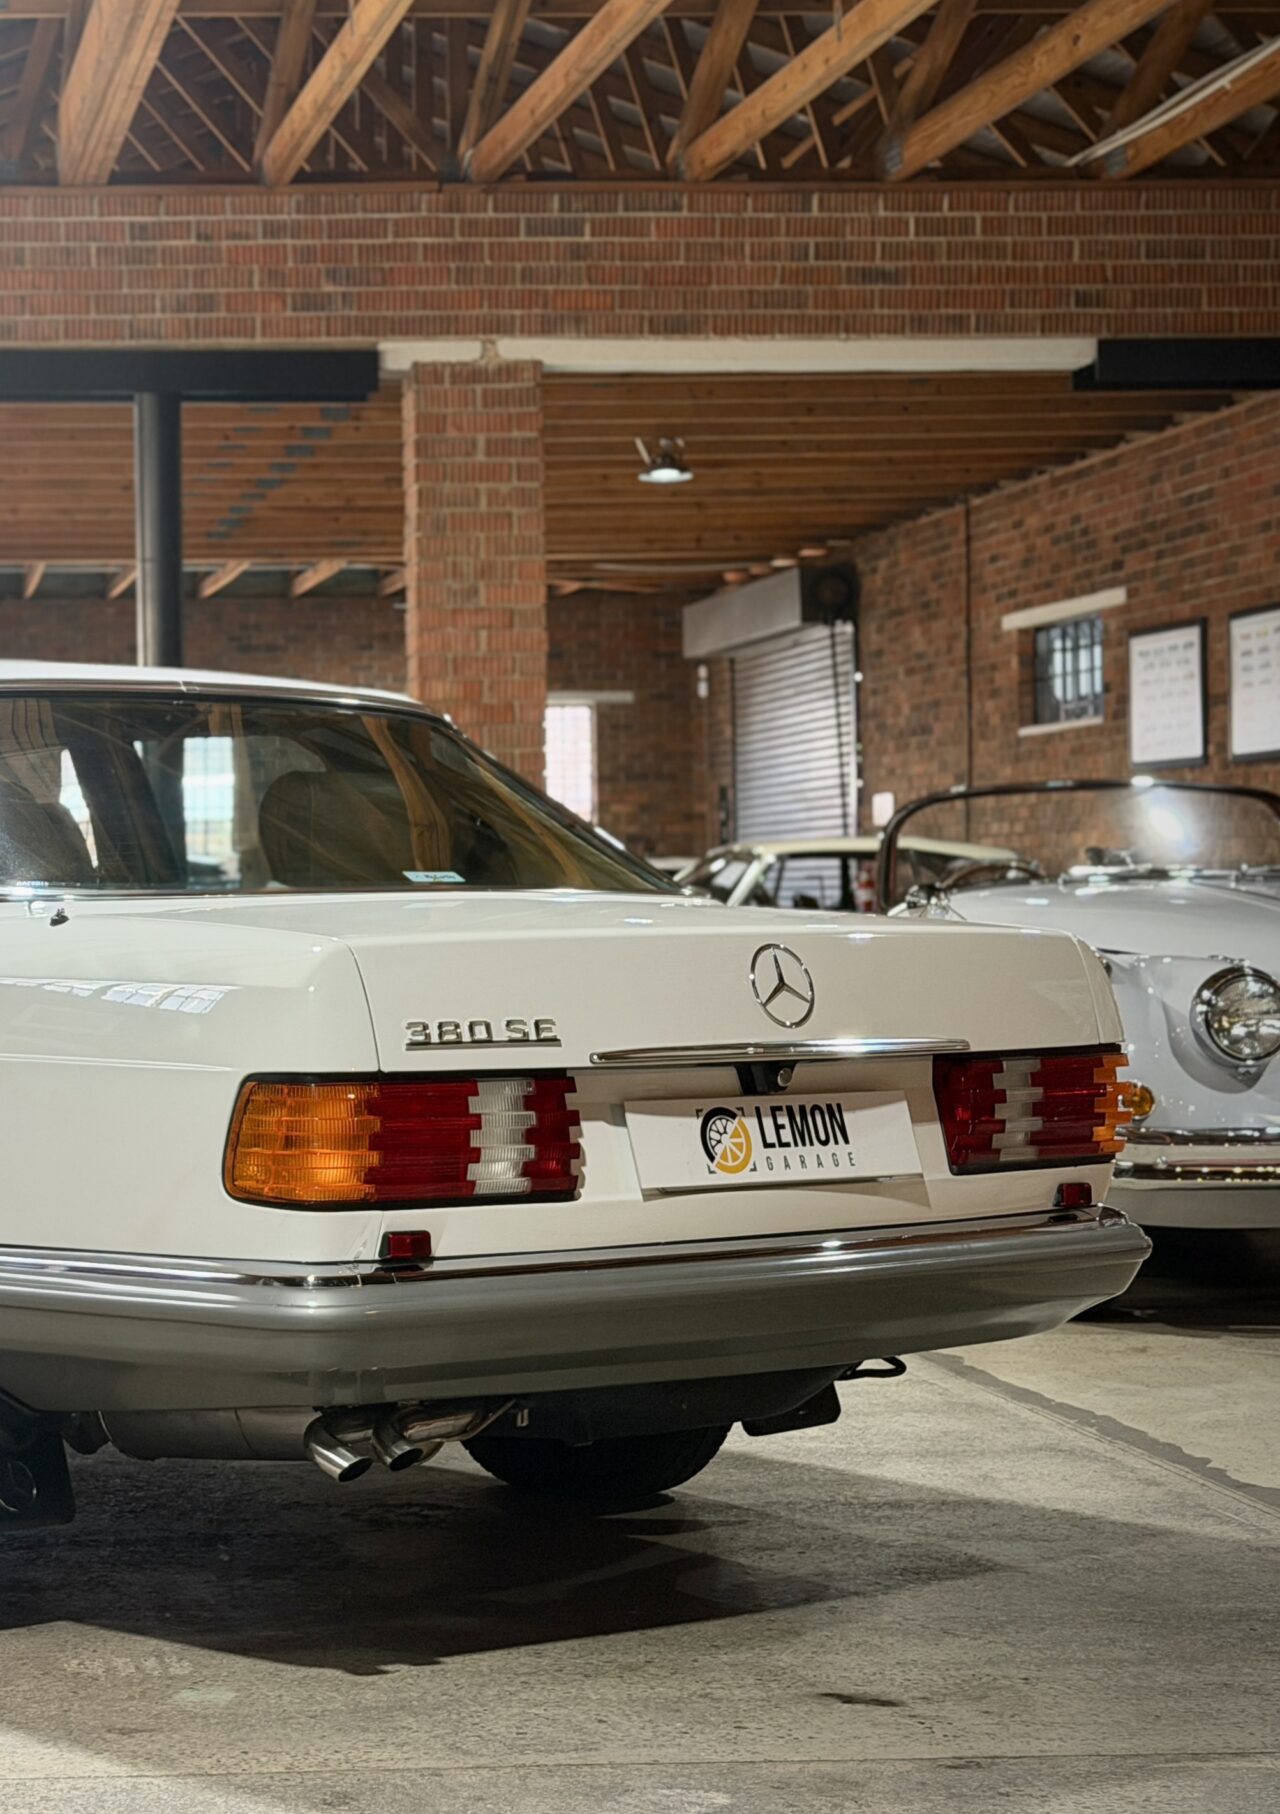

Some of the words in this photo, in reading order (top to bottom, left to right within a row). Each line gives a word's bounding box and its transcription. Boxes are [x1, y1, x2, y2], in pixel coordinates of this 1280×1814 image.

[405, 1020, 493, 1043] 380
[505, 1018, 557, 1041] SE
[754, 1103, 850, 1149] LEMON
[765, 1152, 856, 1171] GARAGE
